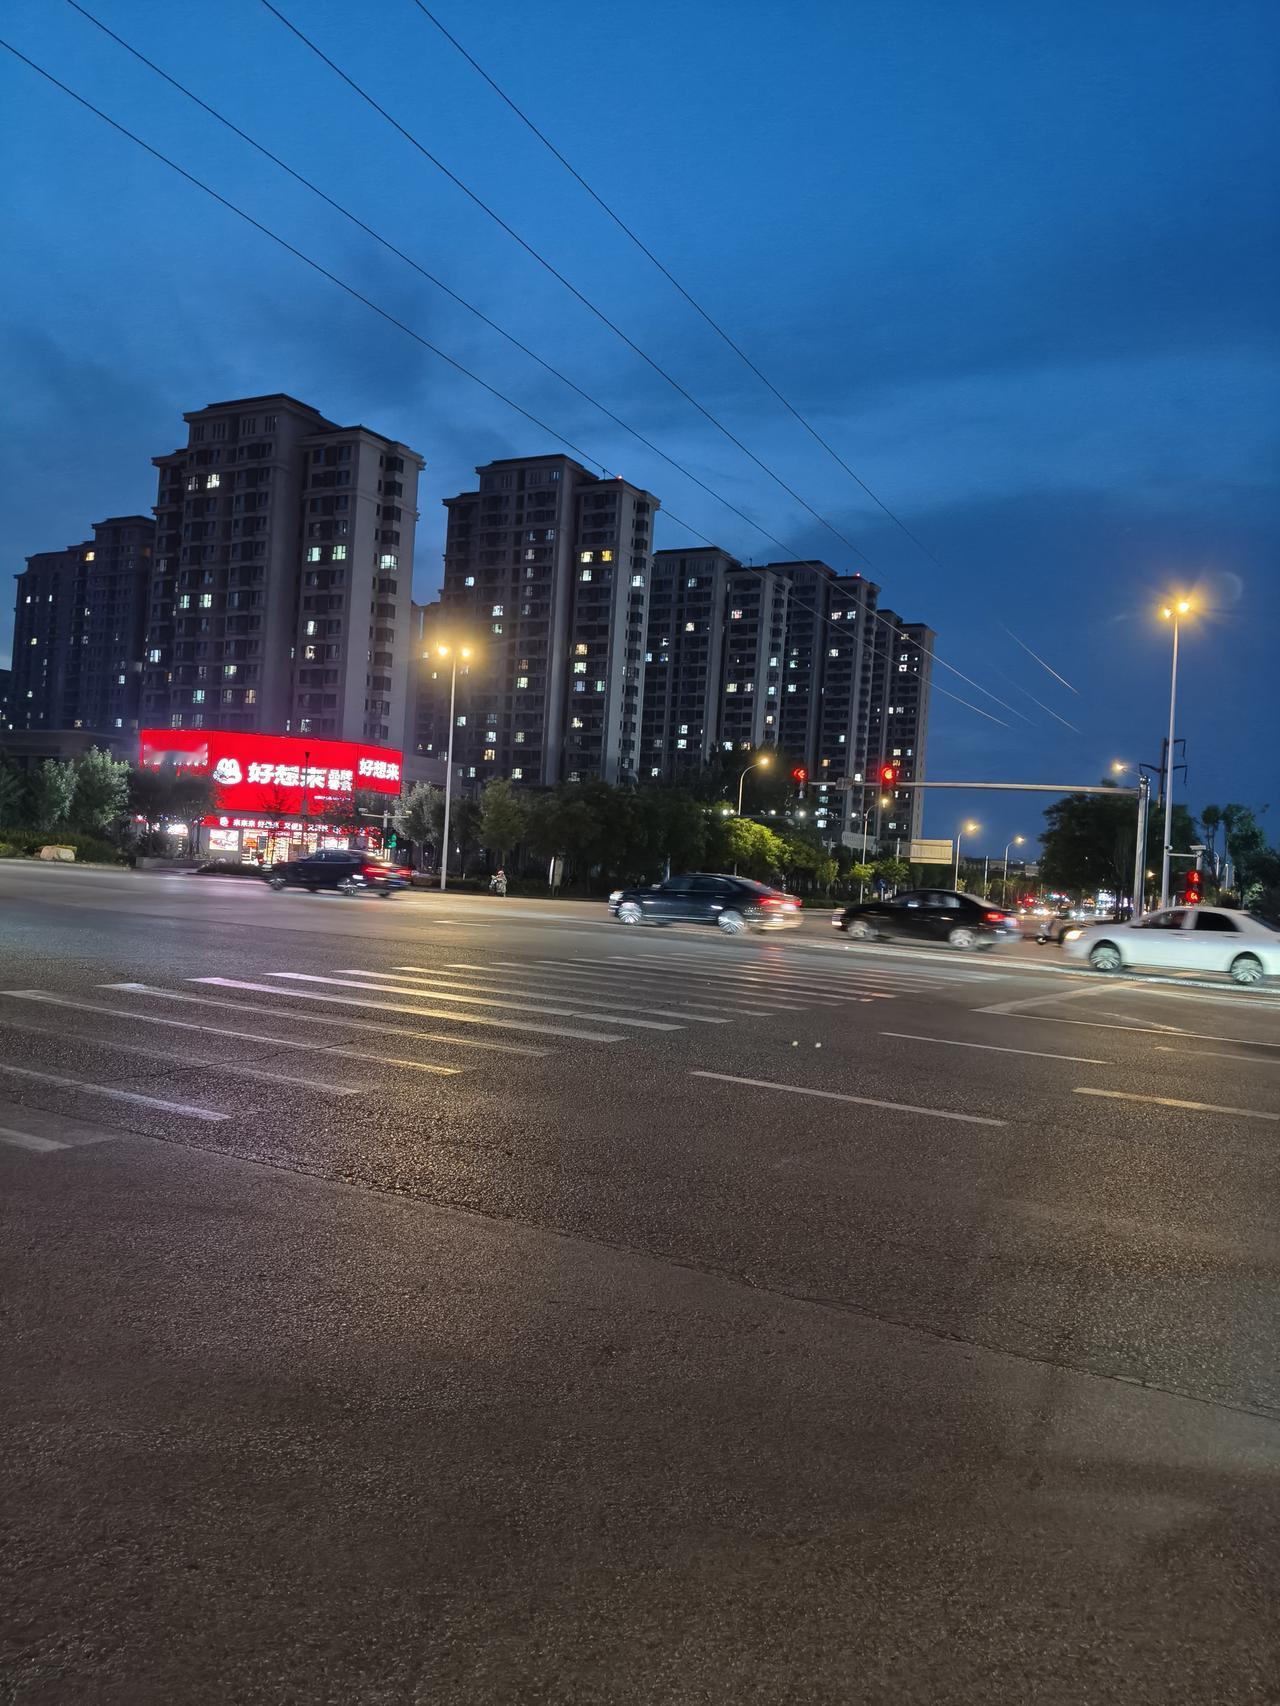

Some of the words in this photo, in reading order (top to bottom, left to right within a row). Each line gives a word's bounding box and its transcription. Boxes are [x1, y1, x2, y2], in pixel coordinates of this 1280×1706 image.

[247, 762, 326, 788] 好想来
[359, 758, 399, 781] 好想来
